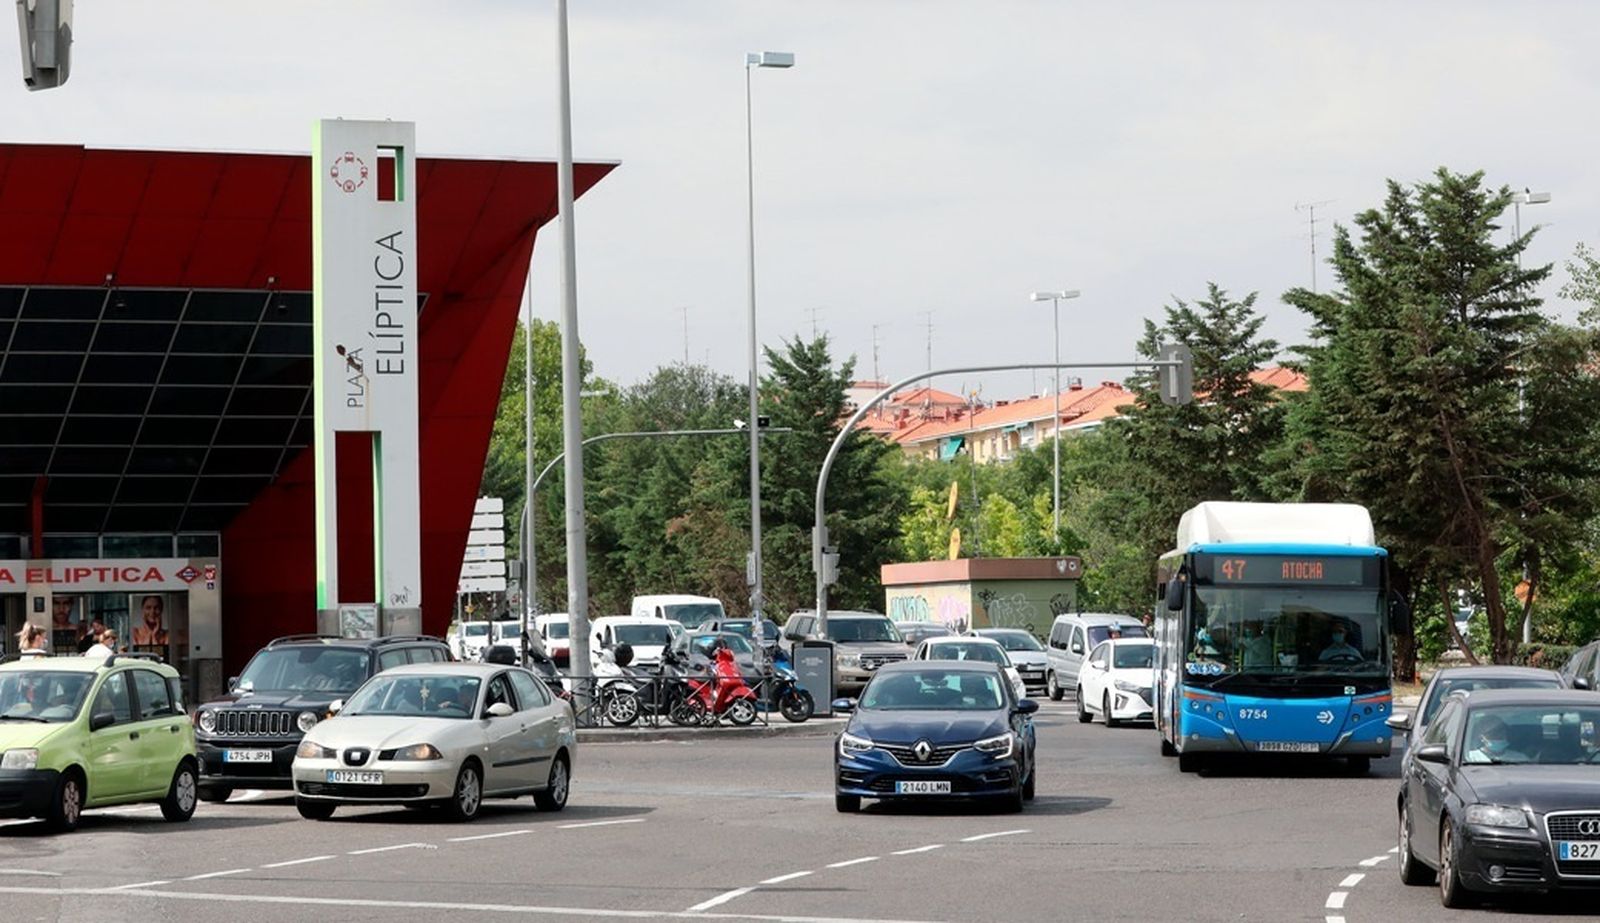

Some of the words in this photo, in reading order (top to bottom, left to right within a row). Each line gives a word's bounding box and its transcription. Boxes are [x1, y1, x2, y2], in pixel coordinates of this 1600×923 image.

[368, 230, 405, 375] ELÍPTICA
[26, 567, 165, 583] ELIPTICA
[1222, 559, 1246, 580] 47
[1282, 561, 1323, 580] ATOCHA
[1239, 708, 1268, 720] 8754
[335, 771, 358, 782] 0121
[902, 782, 928, 792] 2140
[1570, 844, 1598, 858] 827
